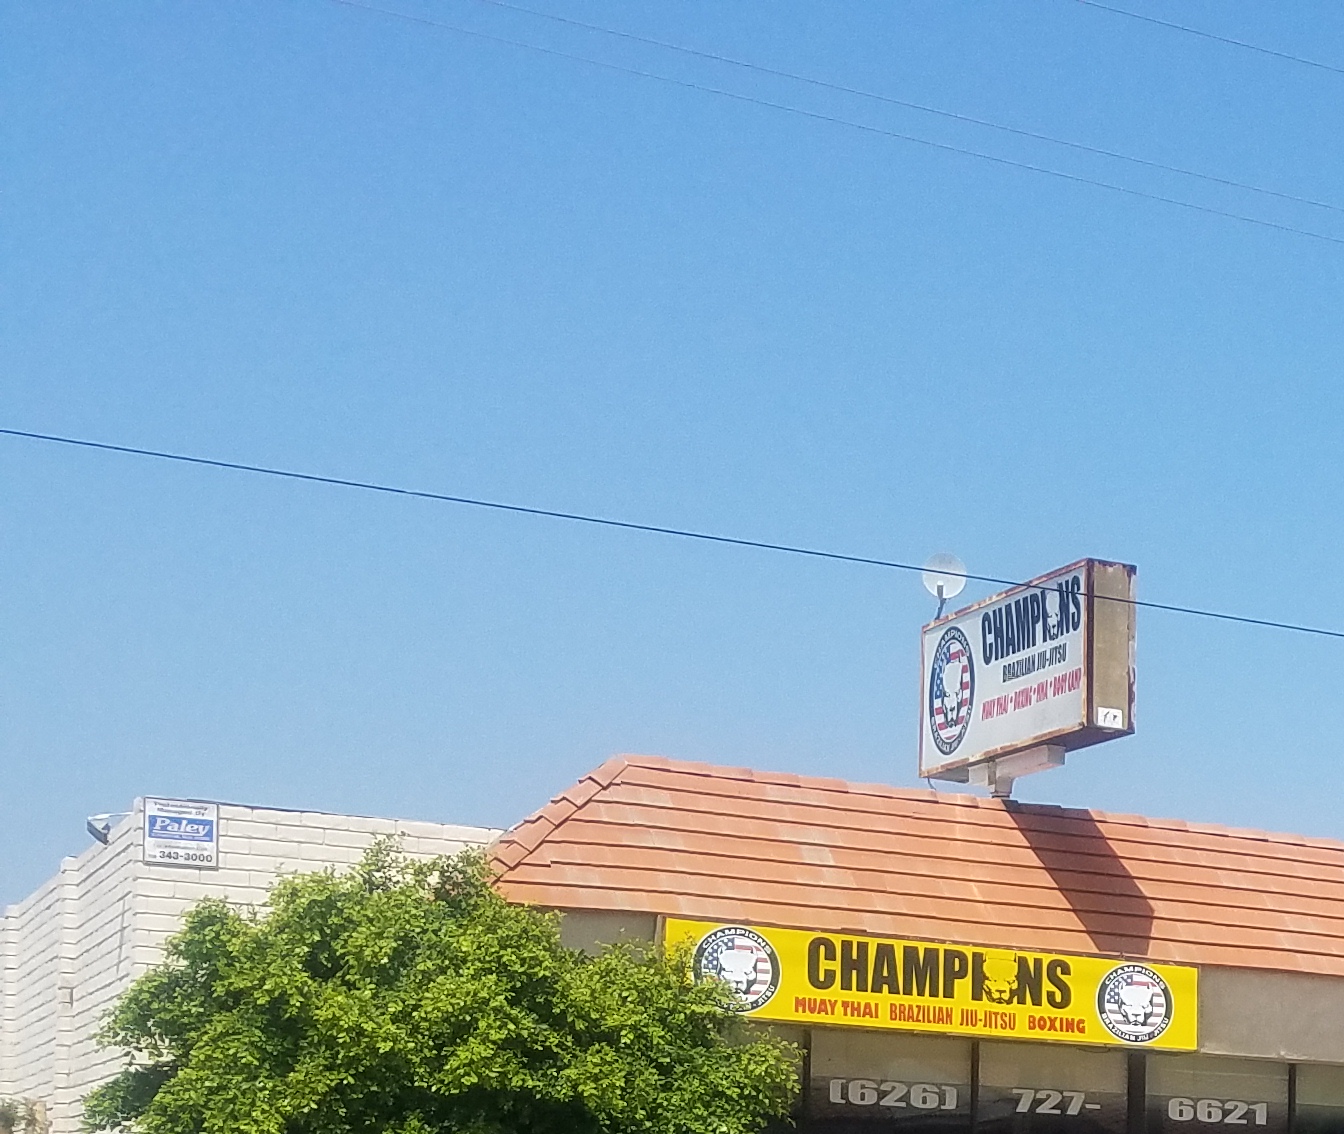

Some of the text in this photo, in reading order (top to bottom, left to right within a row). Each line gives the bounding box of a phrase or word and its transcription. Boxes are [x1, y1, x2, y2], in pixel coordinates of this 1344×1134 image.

[153, 816, 210, 836] Paley
[159, 850, 213, 863] 343-3000
[702, 928, 773, 955] CHAMPIONS
[1105, 965, 1166, 990] CHAMPIONS
[794, 996, 1087, 1035] MUAY THAI BRAZILIAN JIU-JITSU BOXING
[1012, 1088, 1101, 1116] 727-
[1167, 1097, 1268, 1125] 6621
